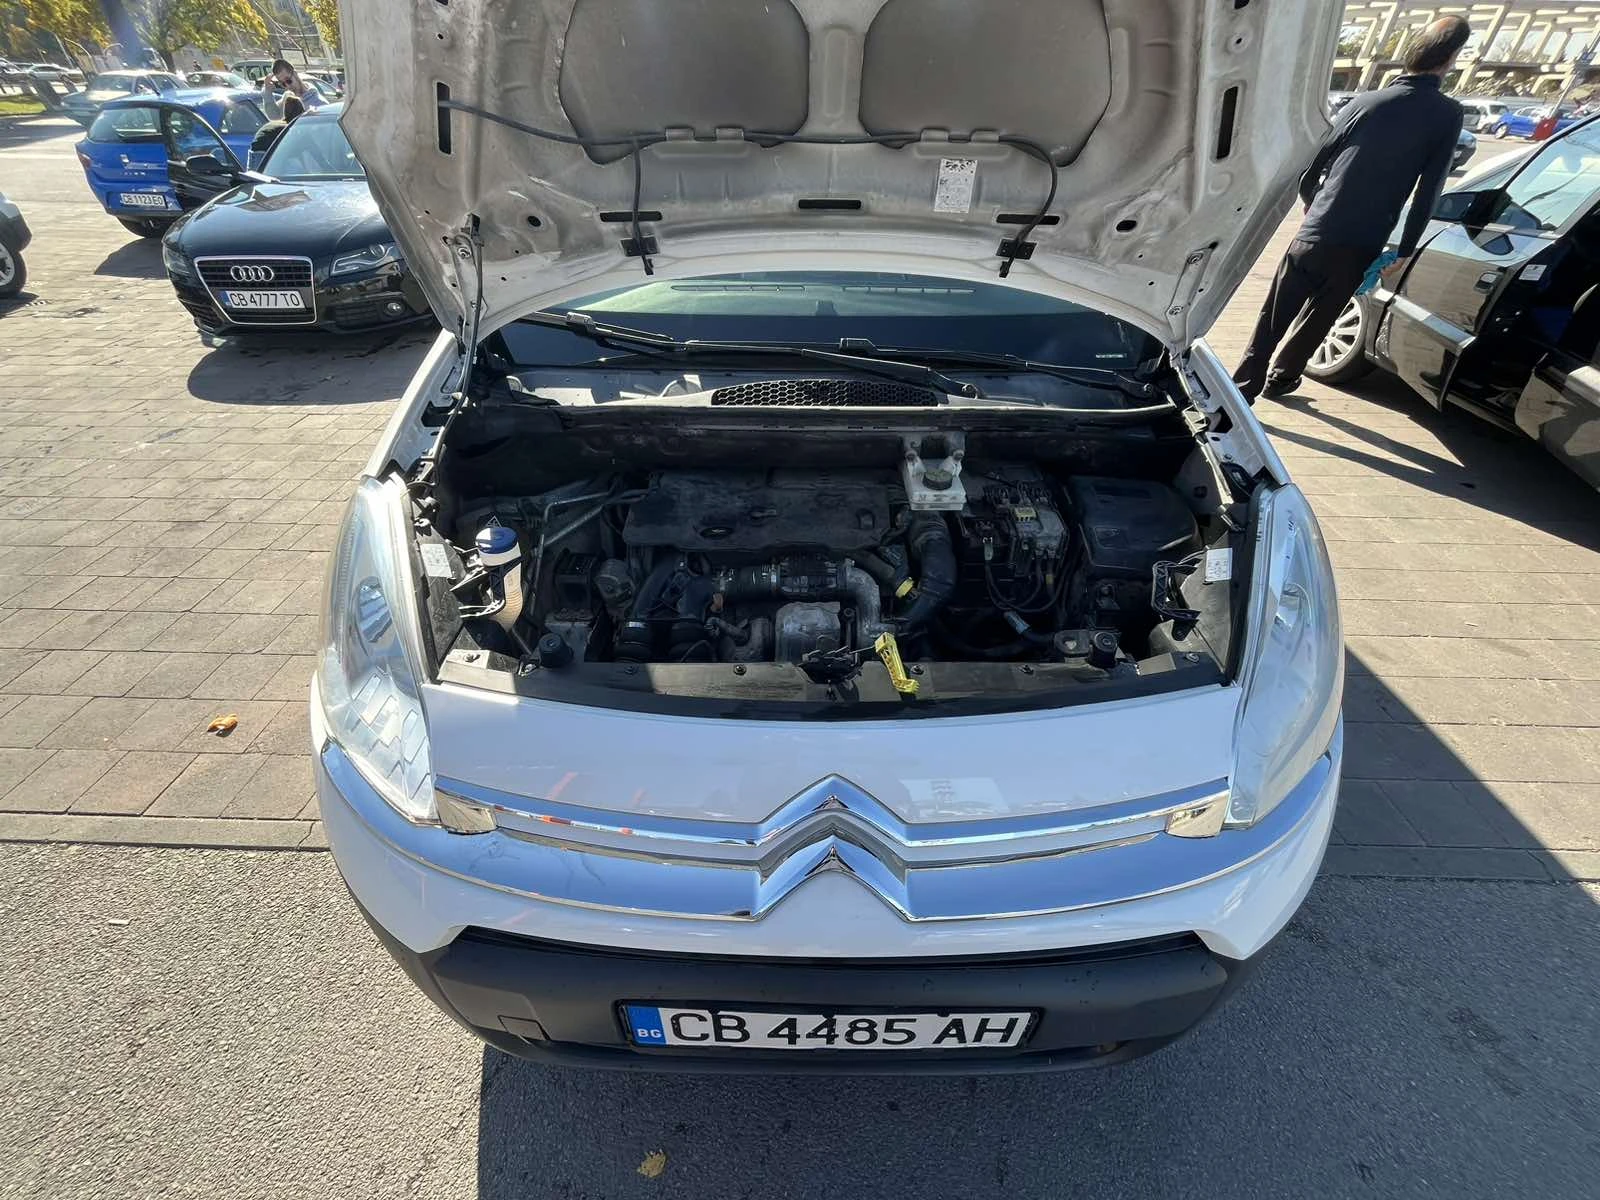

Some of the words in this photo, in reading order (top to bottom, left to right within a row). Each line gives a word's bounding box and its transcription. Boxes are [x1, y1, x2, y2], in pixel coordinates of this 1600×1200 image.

[229, 293, 248, 306] CB
[250, 293, 278, 307] 4777
[280, 293, 300, 307] TO
[637, 1029, 662, 1039] BG
[671, 1013, 751, 1043] CB
[766, 1016, 917, 1047] 4485
[932, 1017, 1019, 1045] AH
